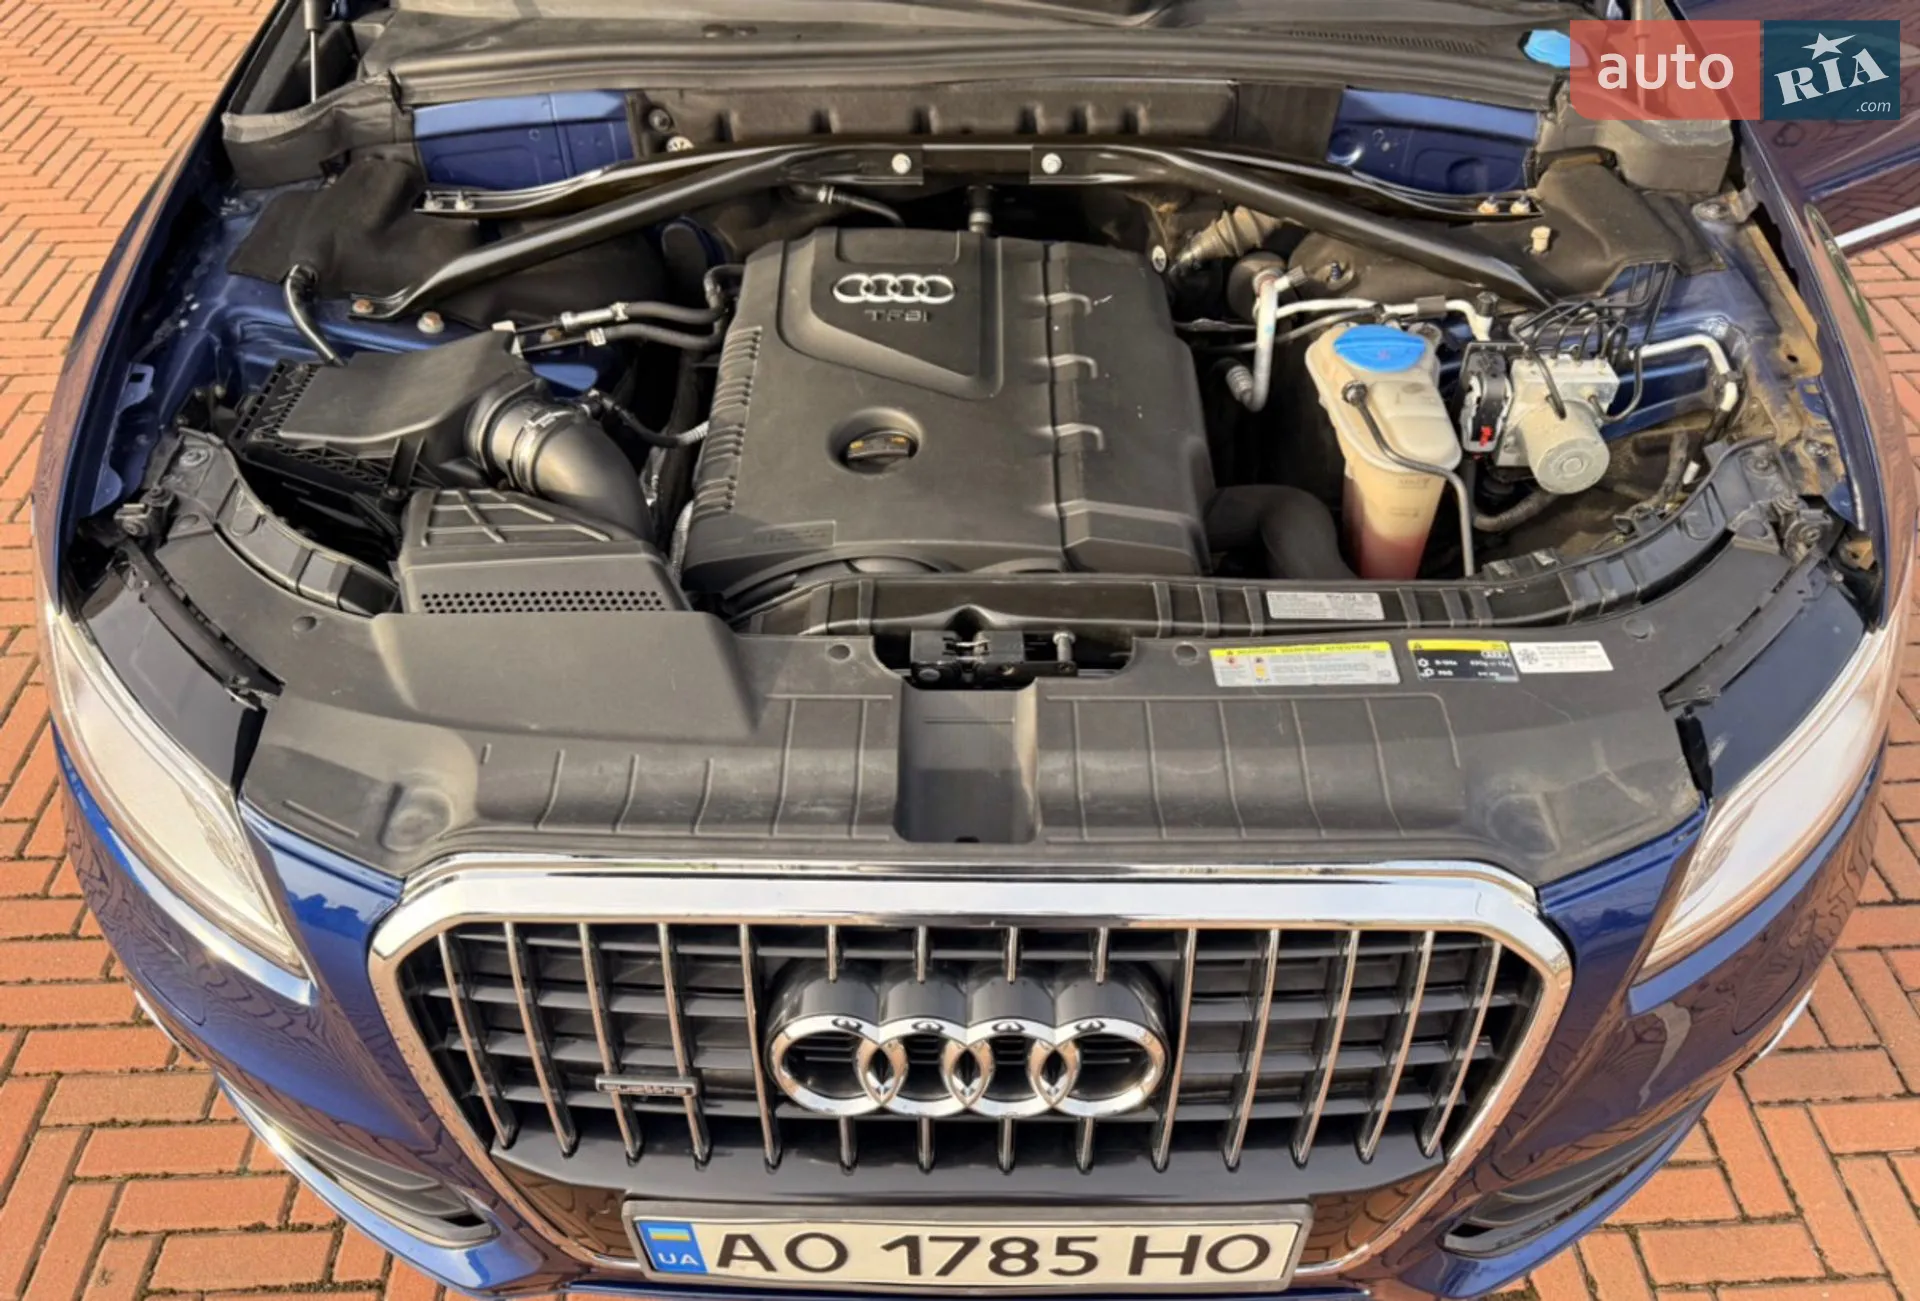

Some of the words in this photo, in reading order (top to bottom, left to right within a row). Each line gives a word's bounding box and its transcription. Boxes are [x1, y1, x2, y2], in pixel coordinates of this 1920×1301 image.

[657, 1252, 701, 1268] UA
[714, 1231, 850, 1274] AO
[879, 1233, 1099, 1277] 1785
[1126, 1232, 1273, 1277] HO
